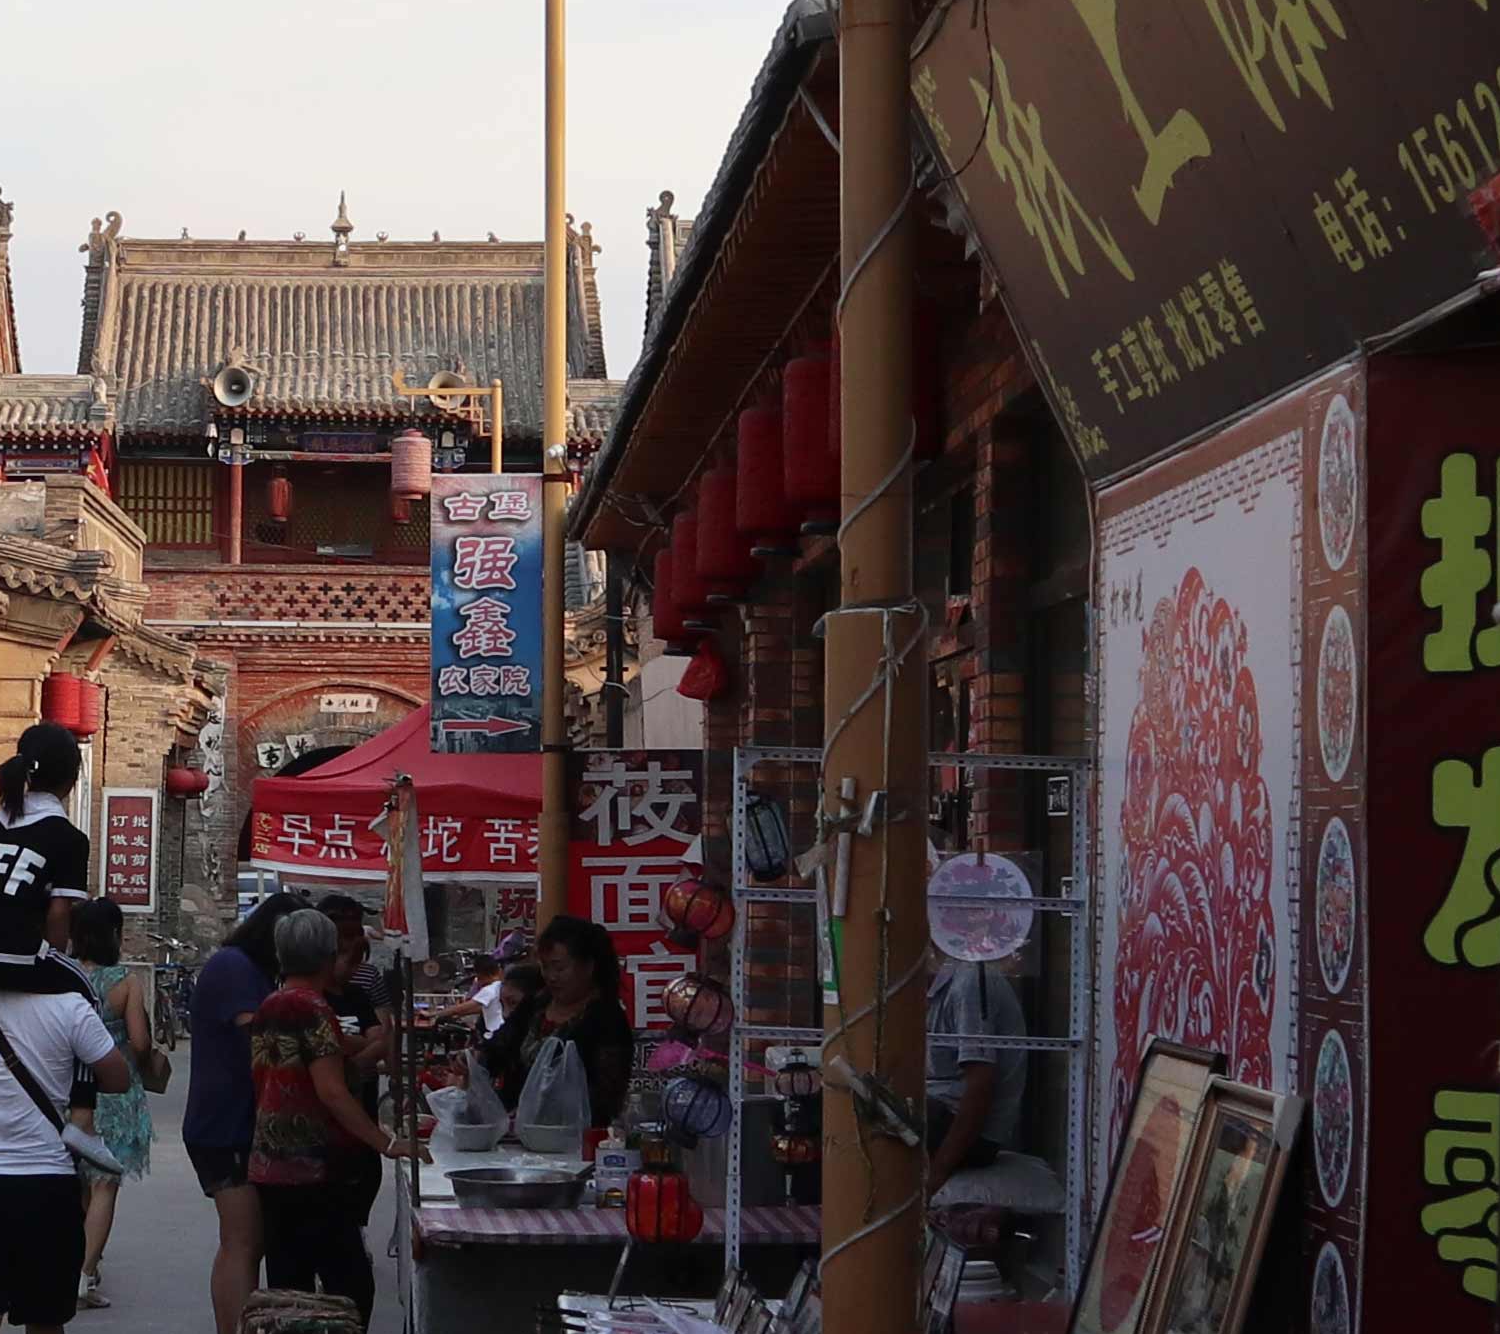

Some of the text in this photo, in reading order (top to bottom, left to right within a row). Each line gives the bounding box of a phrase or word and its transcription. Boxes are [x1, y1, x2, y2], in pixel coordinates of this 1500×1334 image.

[1091, 258, 1266, 414] 手工剪纸 批发零售
[444, 491, 531, 521] 古堡
[438, 664, 531, 696] 农家院
[277, 813, 358, 860] 早点
